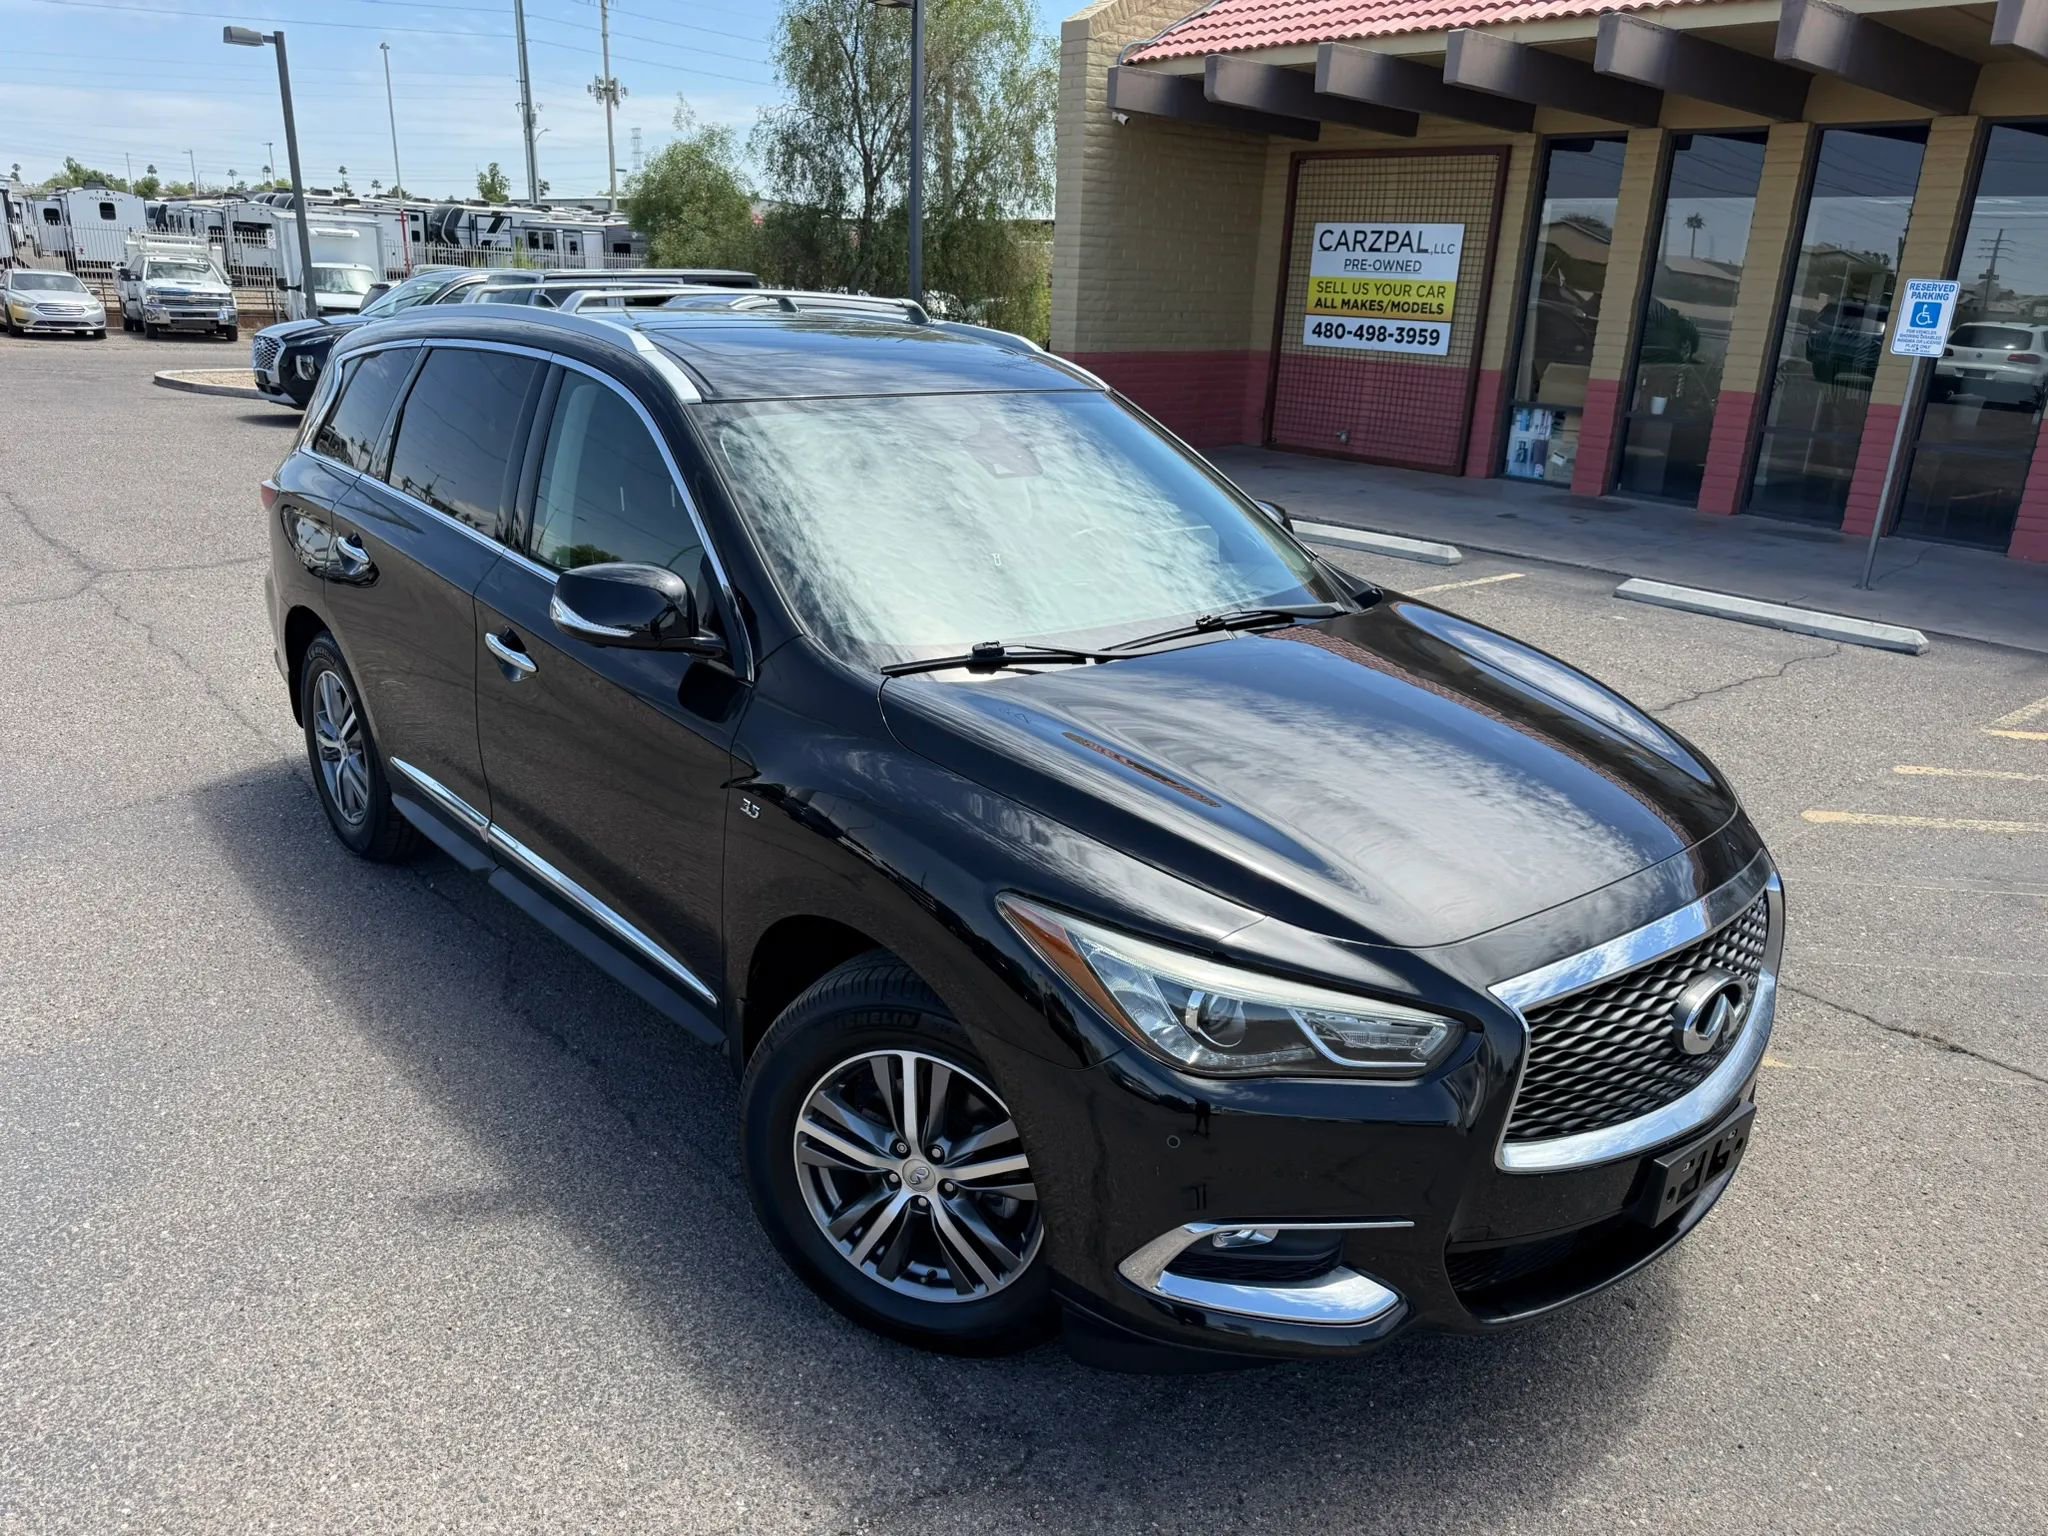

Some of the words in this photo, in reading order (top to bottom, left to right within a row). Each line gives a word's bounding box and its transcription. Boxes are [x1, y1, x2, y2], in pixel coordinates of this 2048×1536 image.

[1343, 258, 1422, 273] PRE-OWNED
[1316, 281, 1348, 295] SELL
[1352, 282, 1369, 295] US
[1373, 283, 1412, 298] YOUR
[1416, 285, 1446, 299] CAR
[1909, 283, 1955, 292] RESERVED
[1911, 292, 1949, 300] PARKING
[1314, 297, 1337, 309] ALL
[1340, 299, 1444, 315] MAKES/MODELS
[1311, 322, 1440, 346] 480-498-3959
